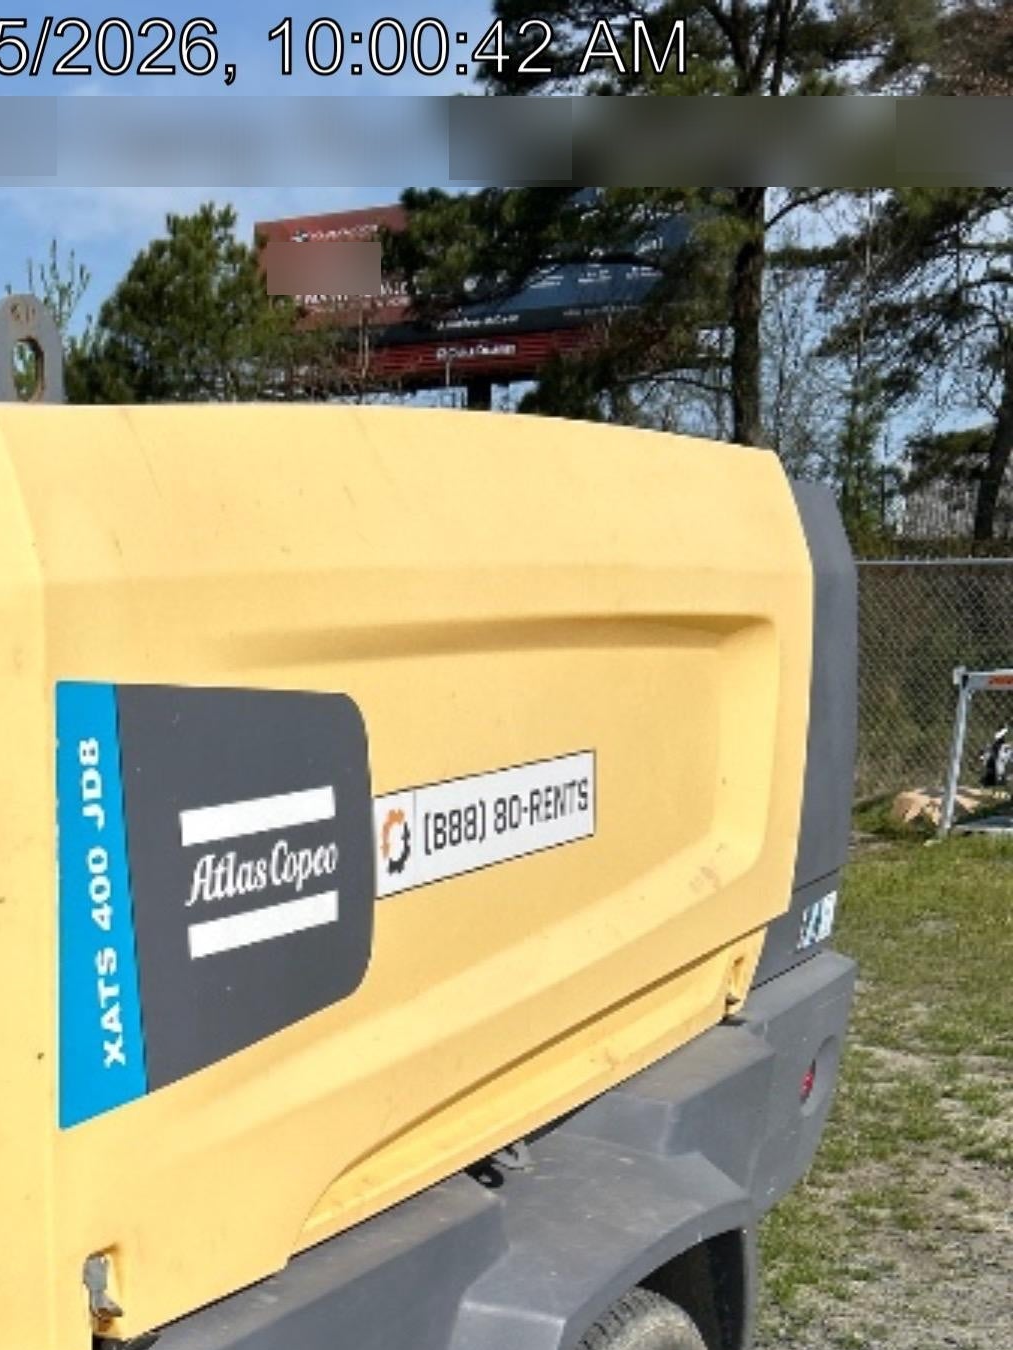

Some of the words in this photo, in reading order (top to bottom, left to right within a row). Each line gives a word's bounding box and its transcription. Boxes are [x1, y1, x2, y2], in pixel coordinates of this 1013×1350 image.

[78, 737, 105, 832] JD8
[494, 777, 588, 835] 80-RENTS
[86, 846, 113, 932] 400
[185, 851, 268, 907] Atlas
[270, 839, 338, 892] Copco
[95, 947, 126, 1069] XATS
